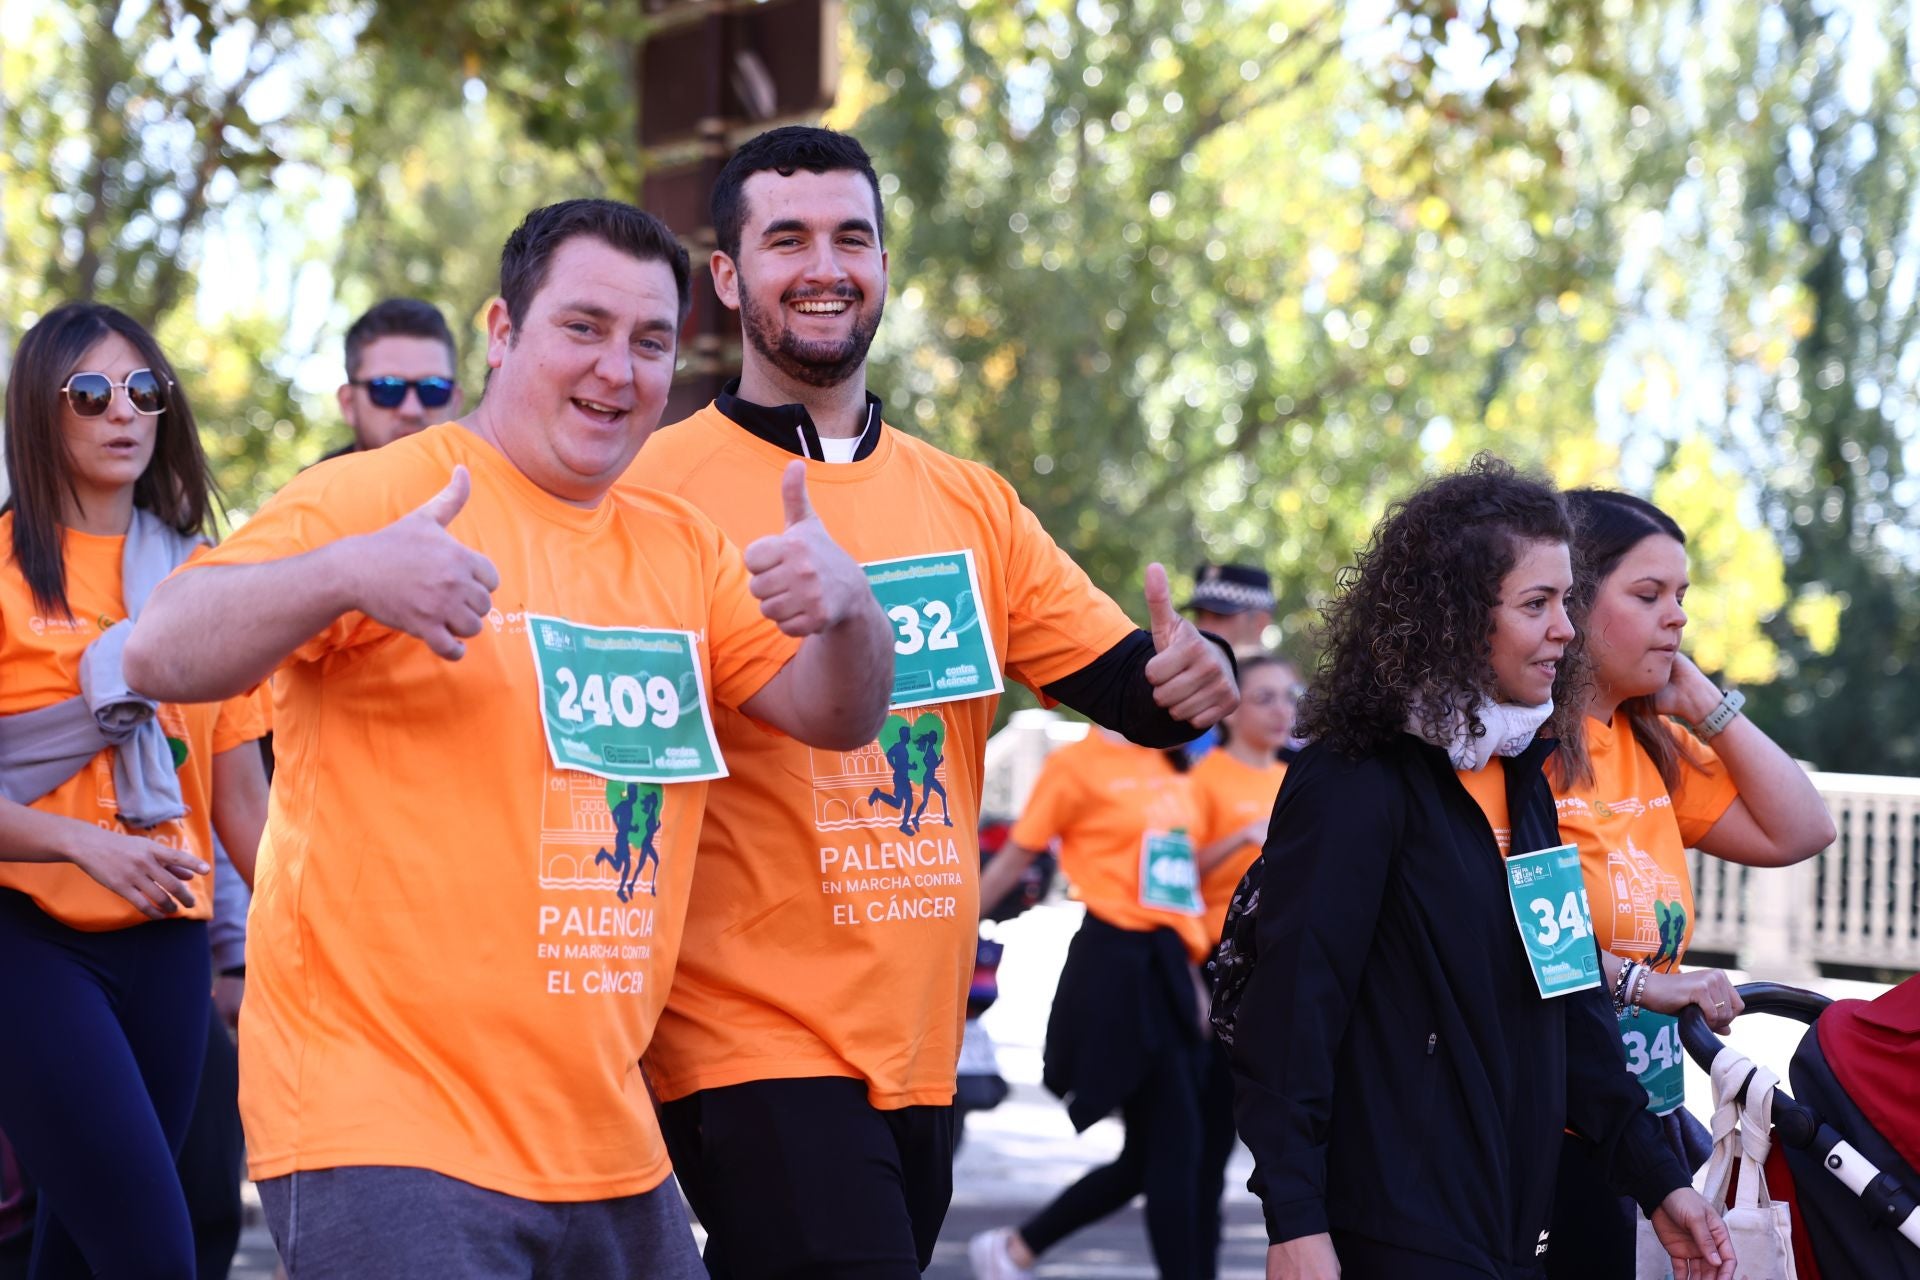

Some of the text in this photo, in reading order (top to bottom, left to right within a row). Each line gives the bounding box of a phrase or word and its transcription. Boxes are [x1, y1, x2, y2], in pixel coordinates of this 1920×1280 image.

[556, 667, 680, 729] 2409
[819, 838, 960, 874] PALENCIA
[822, 872, 963, 894] EN MARCHA CONTRA
[538, 905, 654, 938] PALENCIA
[833, 895, 956, 925] EL CÁNCER
[537, 943, 650, 960] EN MARCHA CONTRA
[547, 963, 644, 994] EL CÁNCER
